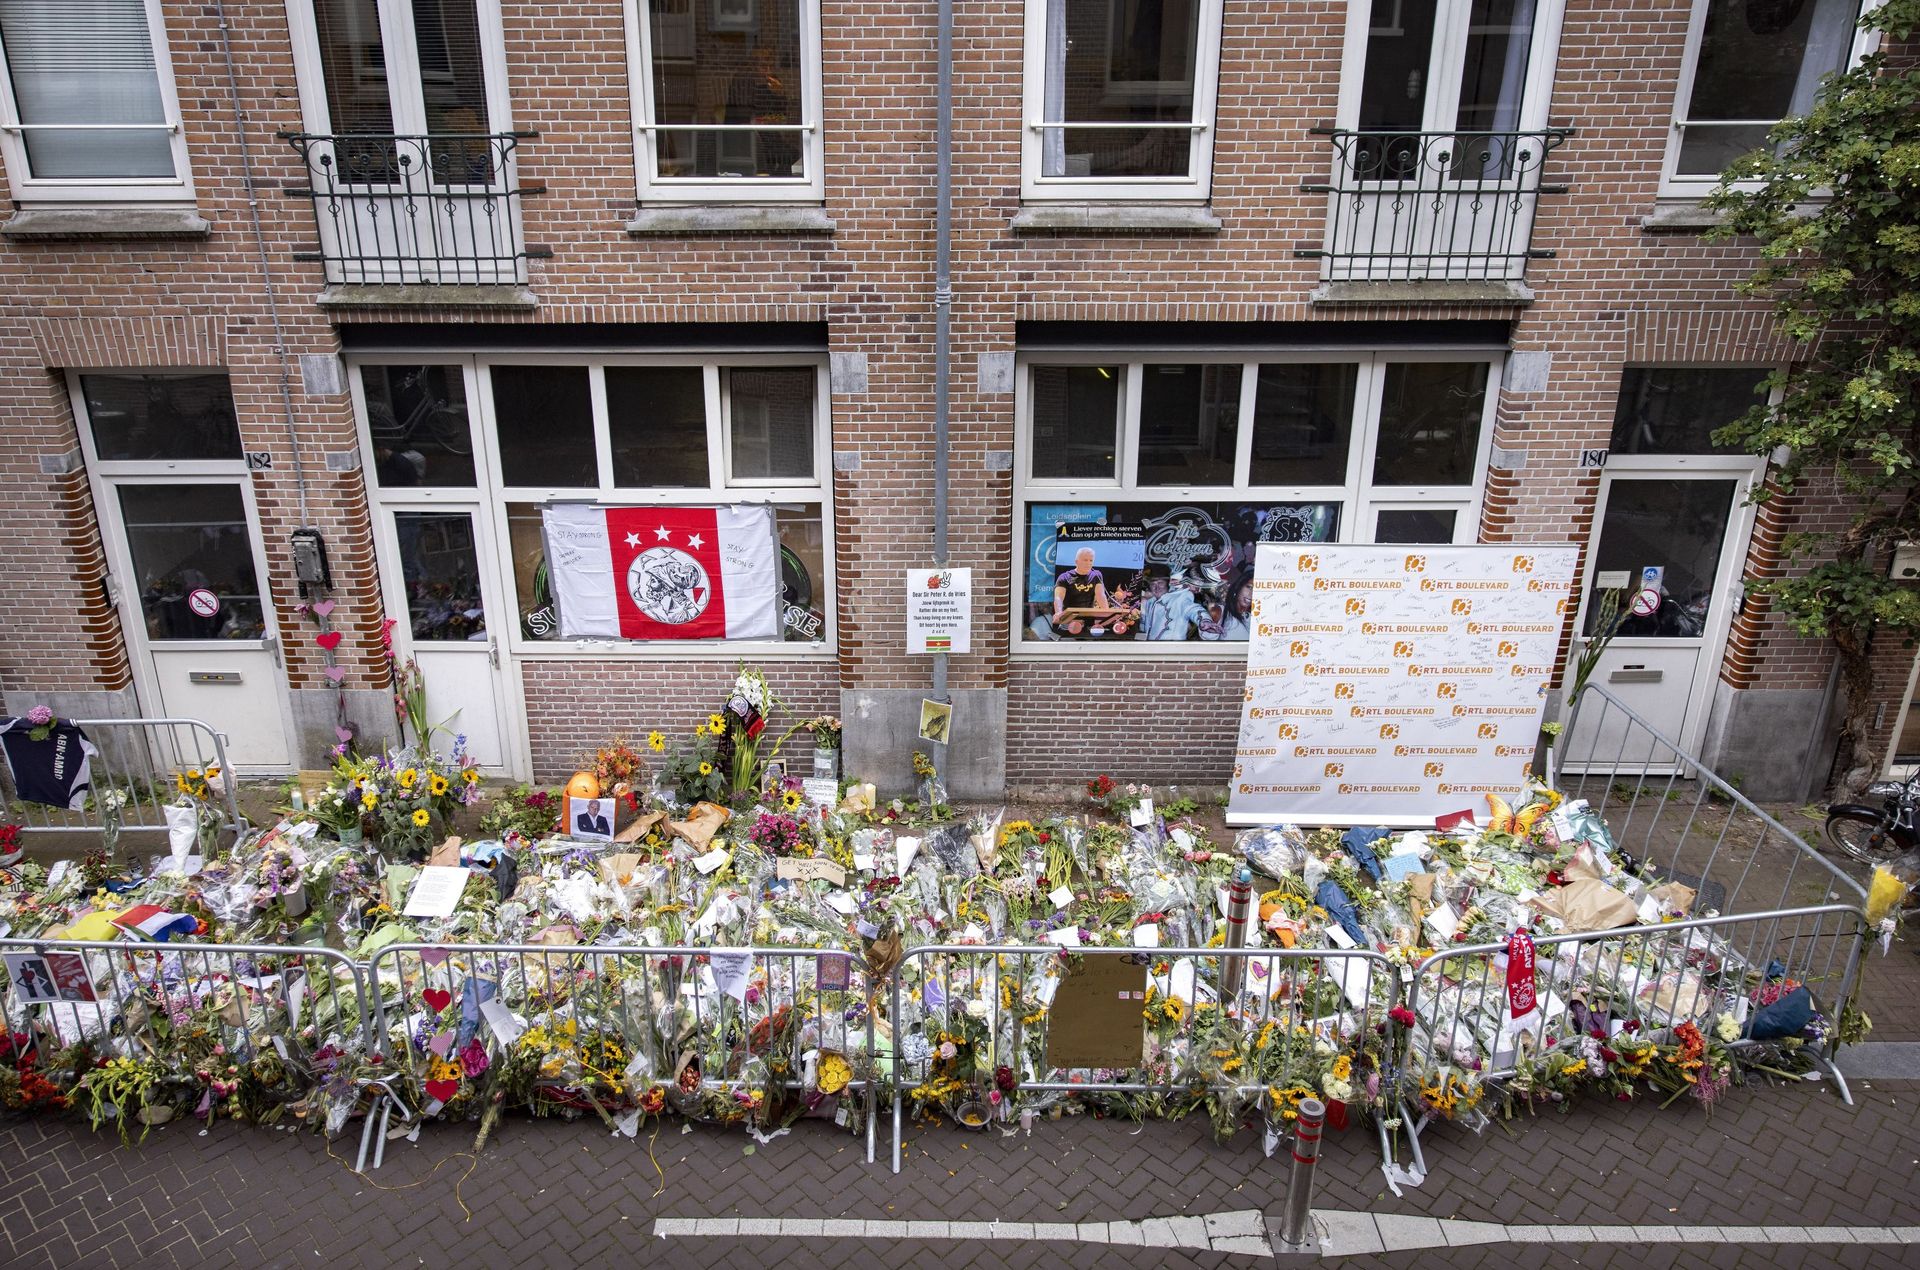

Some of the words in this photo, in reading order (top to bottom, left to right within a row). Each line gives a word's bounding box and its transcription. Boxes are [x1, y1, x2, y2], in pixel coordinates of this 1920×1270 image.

[245, 452, 271, 468] 182
[1581, 450, 1607, 466] 180
[1178, 519, 1200, 538] The
[727, 543, 744, 553] STAY
[726, 556, 754, 568] STRONG
[1255, 582, 1296, 590] ULEVARD
[1349, 581, 1402, 589] BOULEVARD
[1437, 582, 1454, 590] RTL
[1456, 582, 1509, 590] BOULEVARD
[528, 606, 557, 635] SU
[1274, 626, 1291, 634] RTL
[1292, 625, 1344, 633] BOULEVARD
[1378, 625, 1395, 633] RTL
[1483, 625, 1500, 633] RTL
[1502, 625, 1555, 633] BOULEVARD
[1249, 668, 1287, 677] ULEVARD
[1424, 667, 1440, 675] RTL
[1442, 667, 1494, 675] BOULEVARD
[1527, 667, 1544, 675] RTL
[1265, 709, 1281, 717] RTL
[1282, 708, 1333, 716] BOULEVARD
[1384, 708, 1435, 716] BOULEVARD
